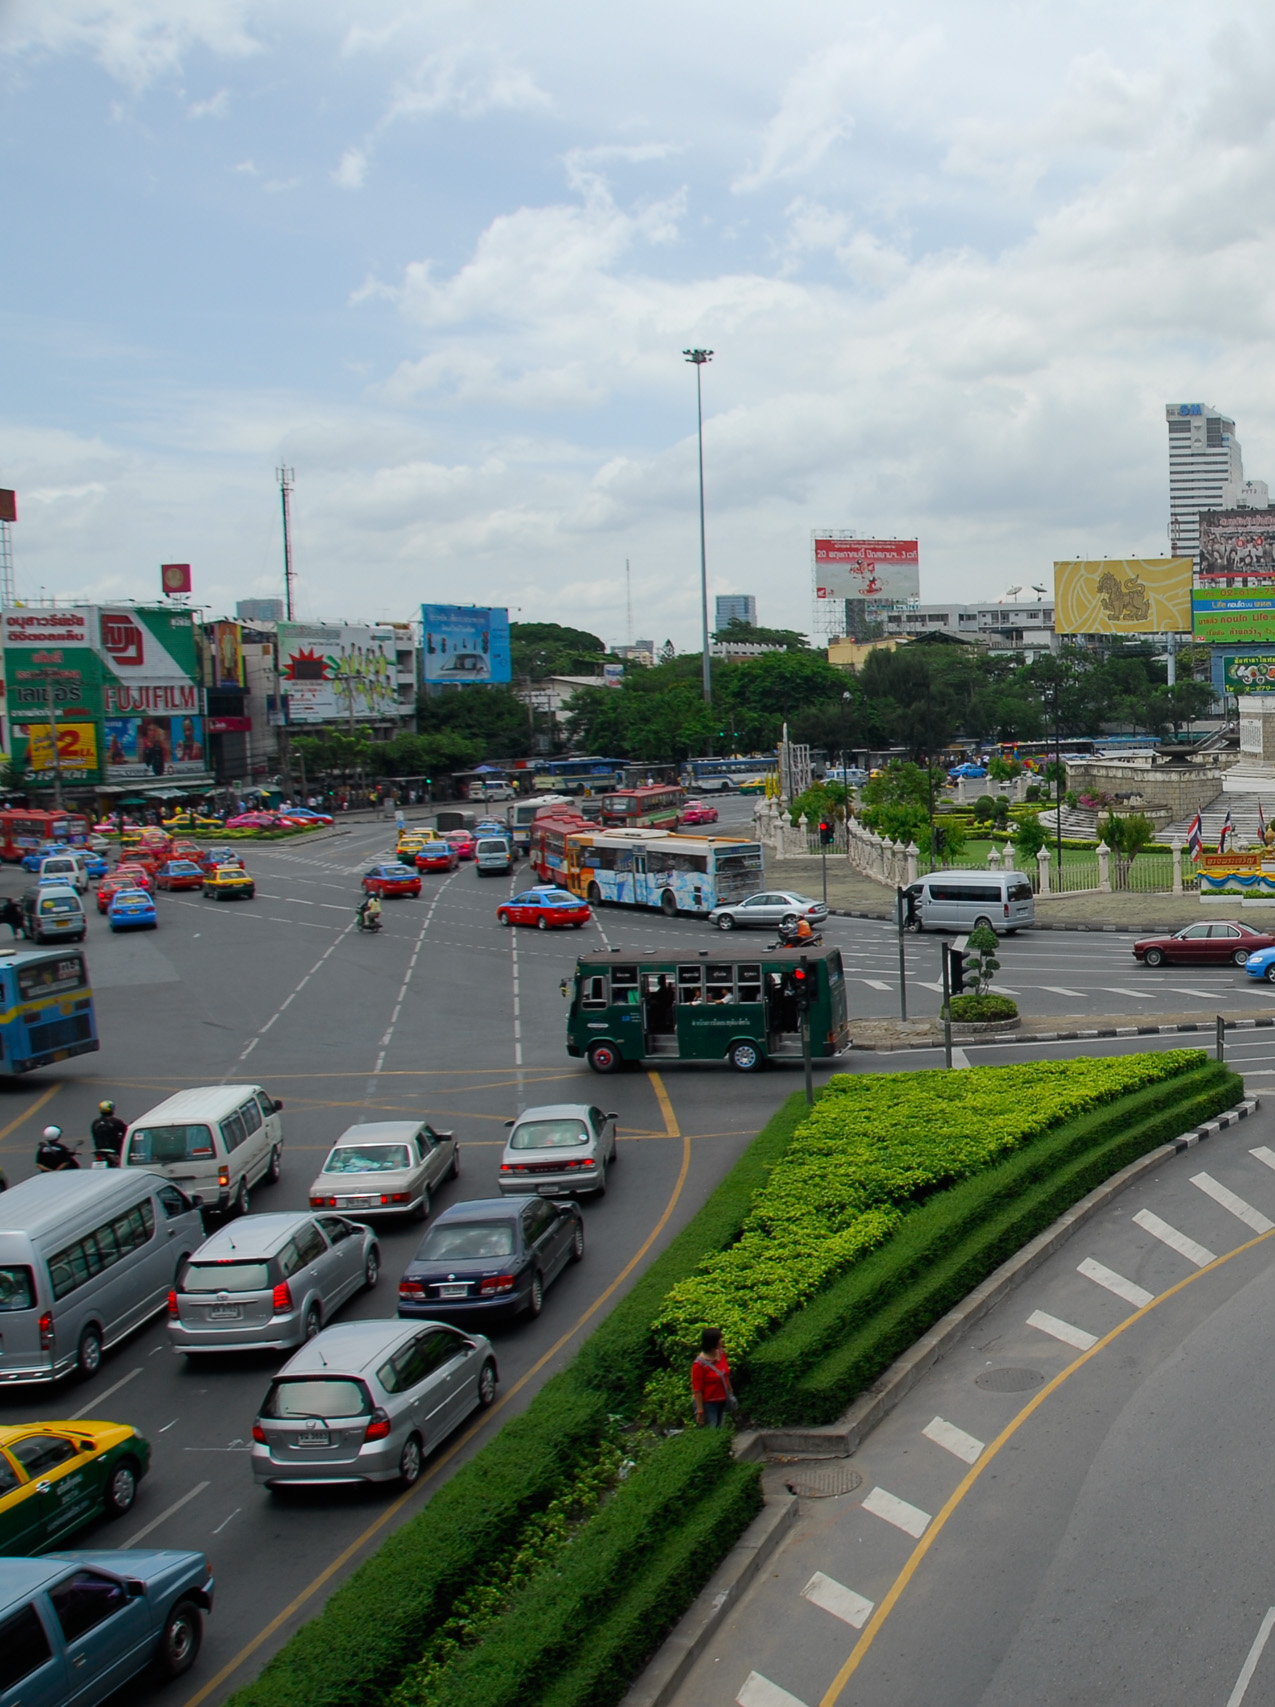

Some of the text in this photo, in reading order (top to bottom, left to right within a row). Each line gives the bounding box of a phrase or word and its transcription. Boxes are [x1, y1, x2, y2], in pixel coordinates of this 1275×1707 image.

[1180, 404, 1202, 416] SM
[1220, 614, 1248, 623] คอนโด
[1252, 612, 1269, 622] Life
[104, 685, 196, 712] FUJIFILM
[58, 730, 80, 757] 2
